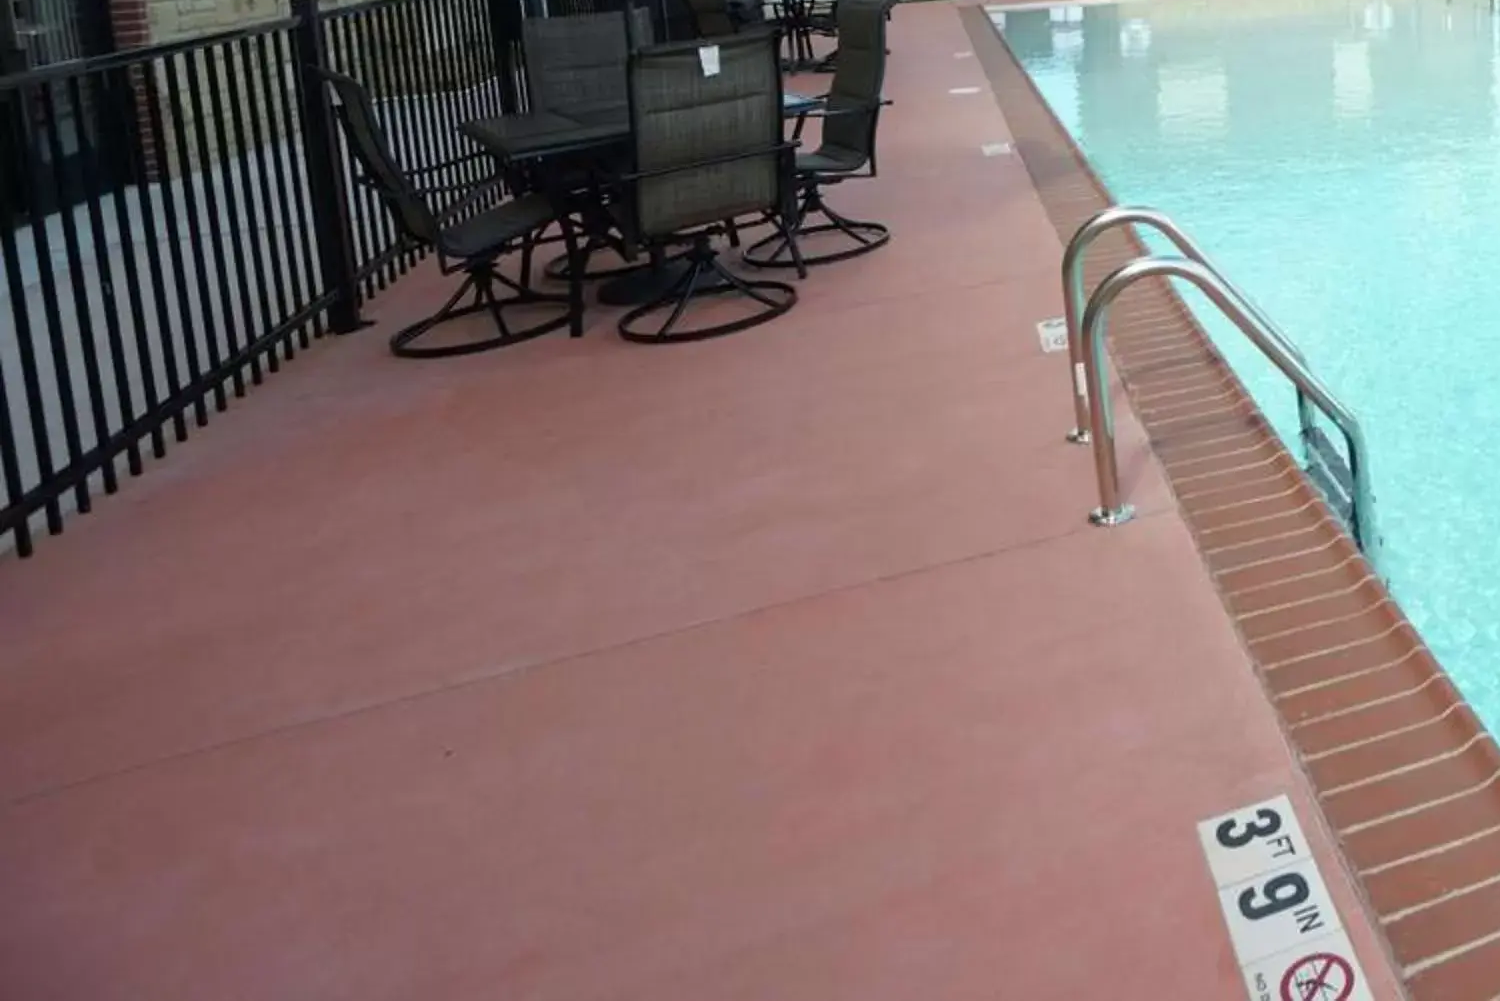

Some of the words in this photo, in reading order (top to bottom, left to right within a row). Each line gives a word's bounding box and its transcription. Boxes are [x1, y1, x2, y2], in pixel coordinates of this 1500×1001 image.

[1216, 808, 1282, 848] 3
[1266, 833, 1296, 858] FT
[1238, 872, 1310, 921] 9
[1293, 903, 1325, 934] IN
